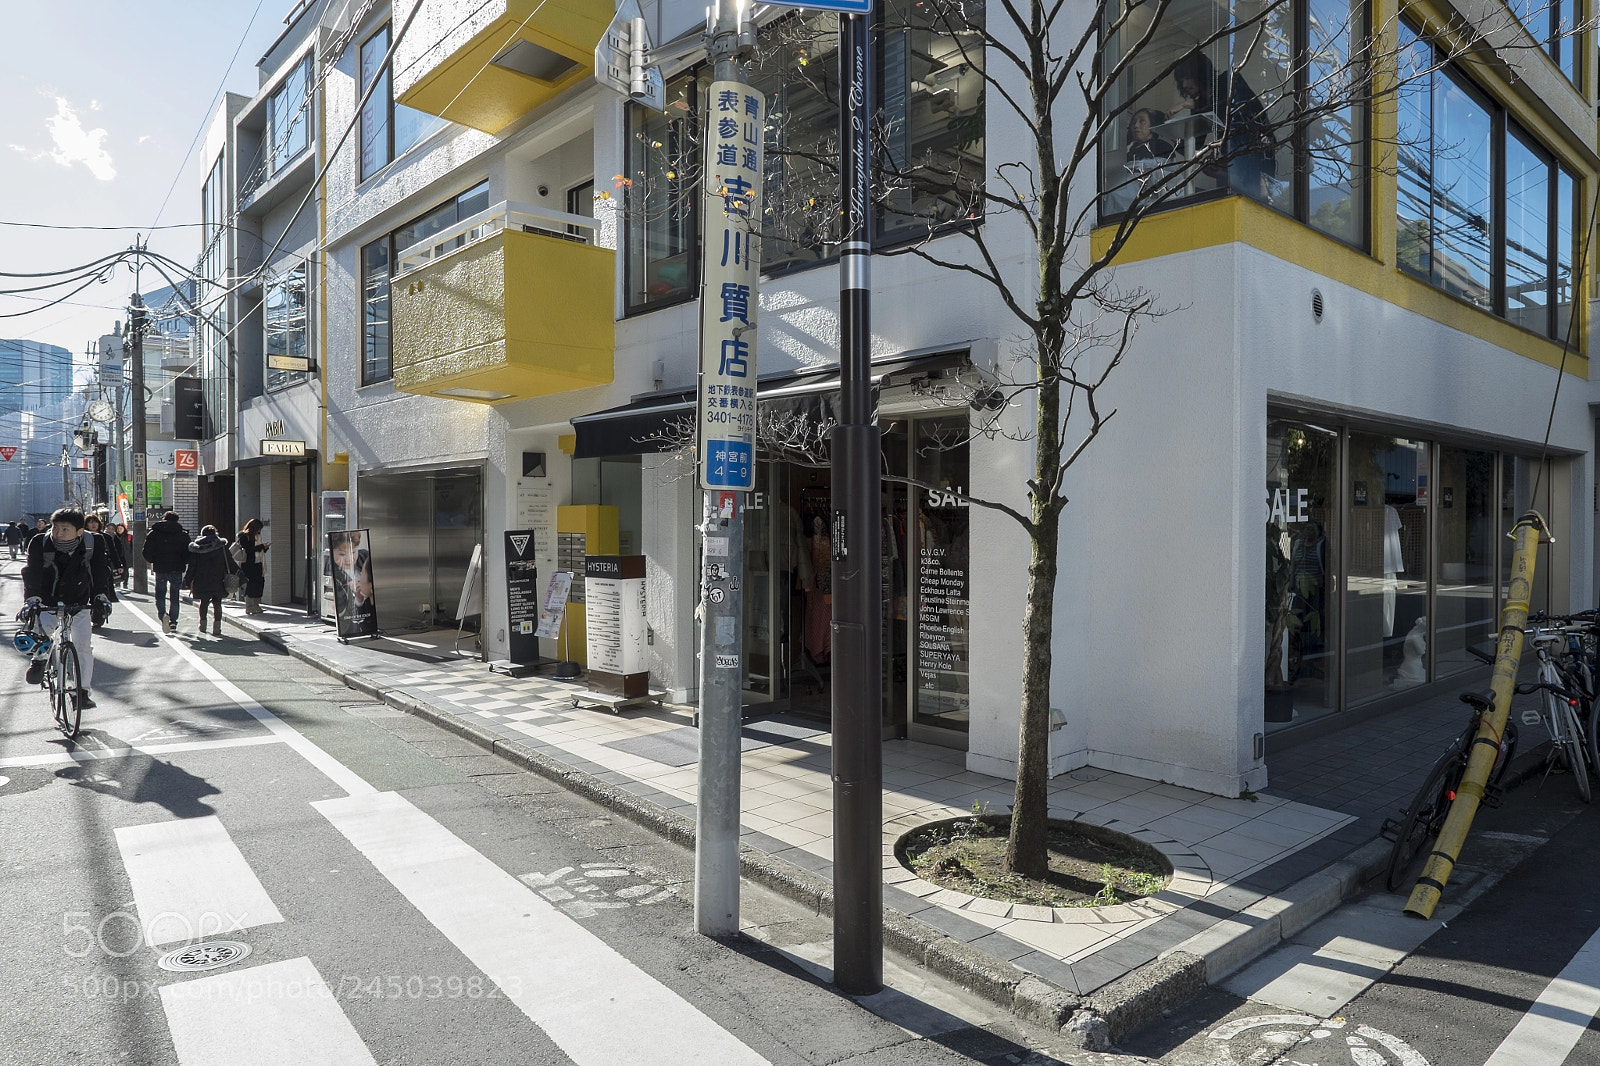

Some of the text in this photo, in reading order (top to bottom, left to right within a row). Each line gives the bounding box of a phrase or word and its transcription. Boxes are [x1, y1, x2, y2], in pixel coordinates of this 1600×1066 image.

[716, 89, 739, 167] 表参道
[742, 94, 759, 173] 青山通
[849, 45, 866, 228] Harajuku 2 Chome
[718, 175, 751, 378] 吉川質店
[708, 397, 753, 411] 交番横入る
[707, 411, 753, 426] 3401-4178
[267, 443, 300, 454] FABIA
[180, 453, 195, 464] 76
[715, 449, 748, 464] 神宮前
[744, 492, 764, 510] LE
[921, 548, 947, 556] G.V.G.V.
[587, 562, 619, 573] HYSTERIA
[920, 576, 964, 588] Cheap Monday
[920, 586, 961, 597] Eckhaus Latta
[920, 614, 940, 622] MSGM
[942, 625, 964, 635] English
[920, 650, 960, 662] SUPERYAYA
[919, 659, 937, 669] Henry
